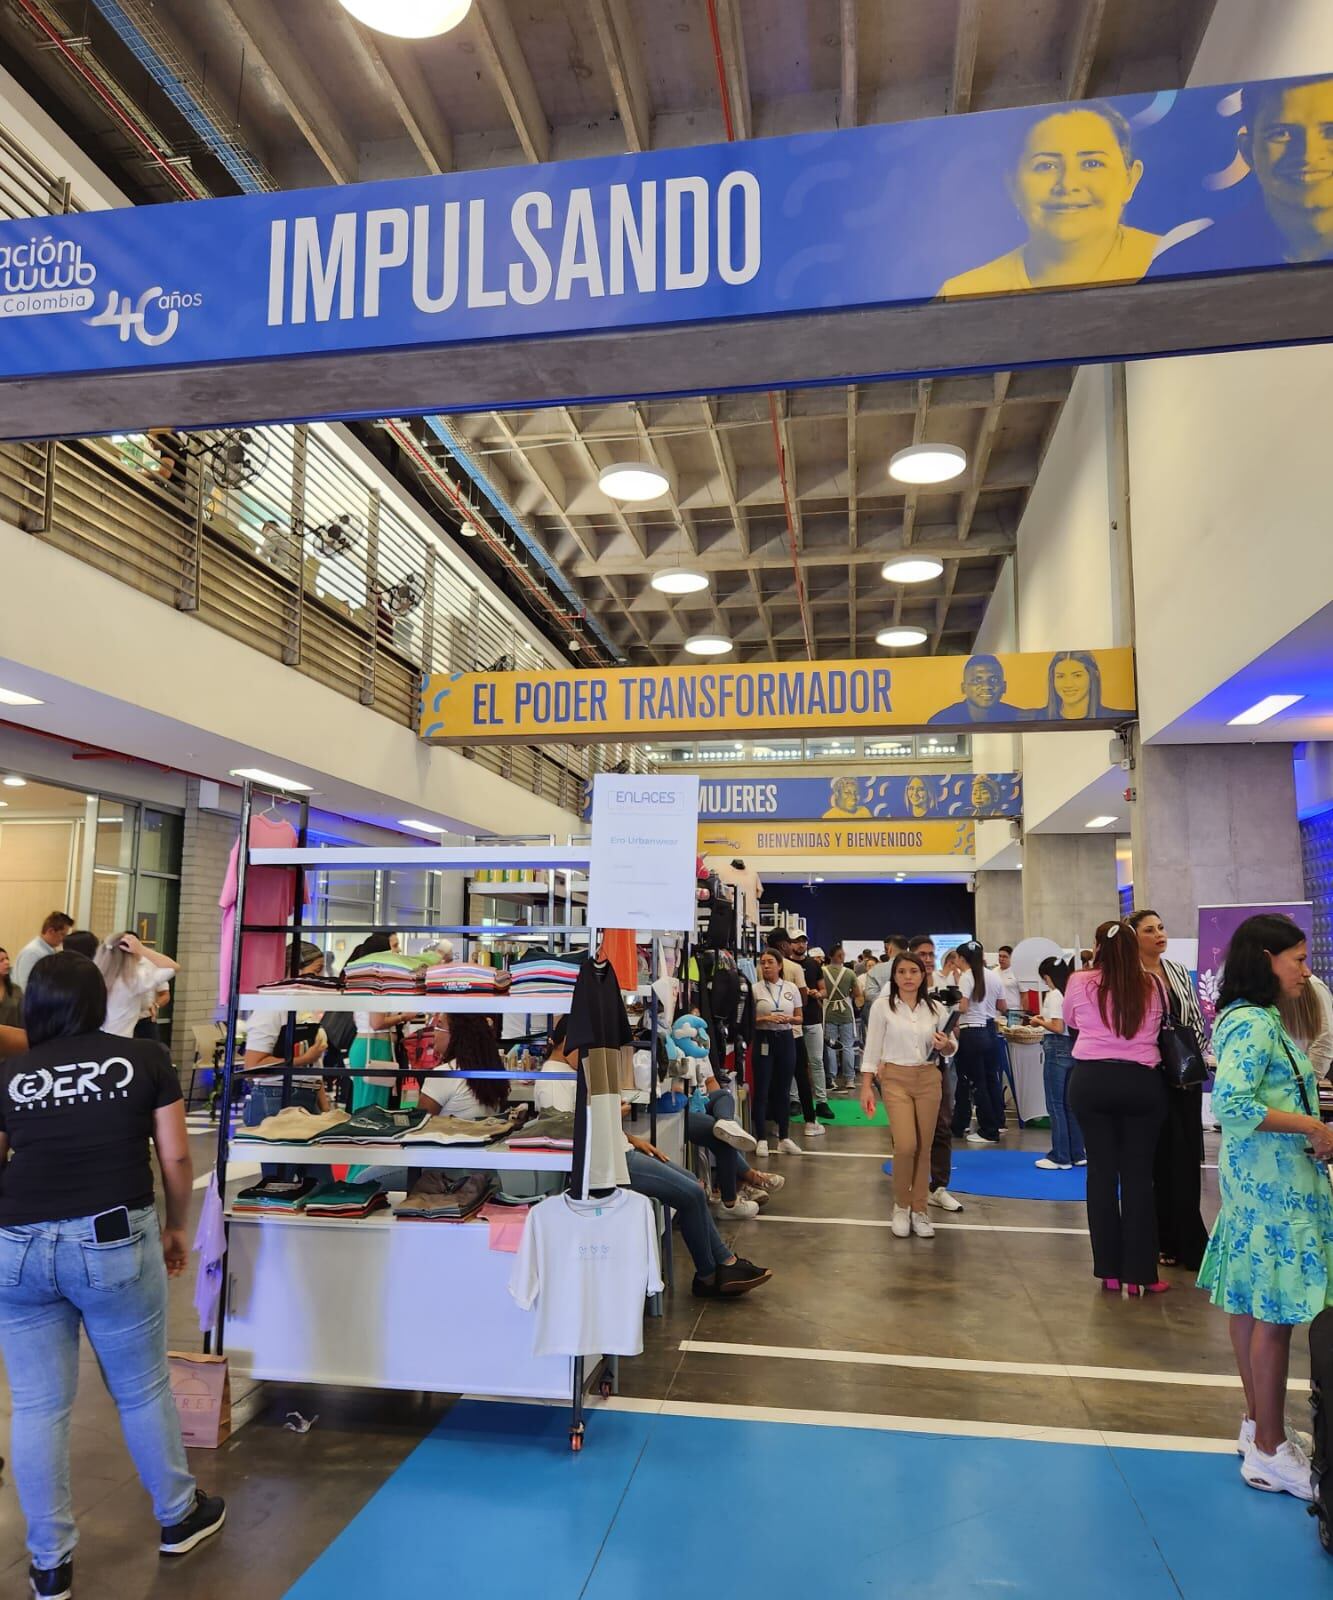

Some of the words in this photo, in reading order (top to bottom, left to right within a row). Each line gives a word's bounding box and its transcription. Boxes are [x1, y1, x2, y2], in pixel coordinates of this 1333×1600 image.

[5, 245, 97, 292] wwb
[267, 170, 761, 327] IMPULSANDO
[4, 290, 86, 313] Colombia
[82, 286, 179, 346] 40
[158, 291, 202, 310] años
[473, 683, 504, 725] EL
[515, 679, 607, 723] PODER
[619, 669, 892, 721] TRANSFORMADOR
[616, 791, 676, 804] ENLACES
[757, 832, 830, 849] BIENVENIDAS
[835, 832, 841, 848] Y
[847, 831, 922, 848] BIENVENIDOS
[140, 918, 148, 940] 1
[53, 1056, 134, 1098] ERO
